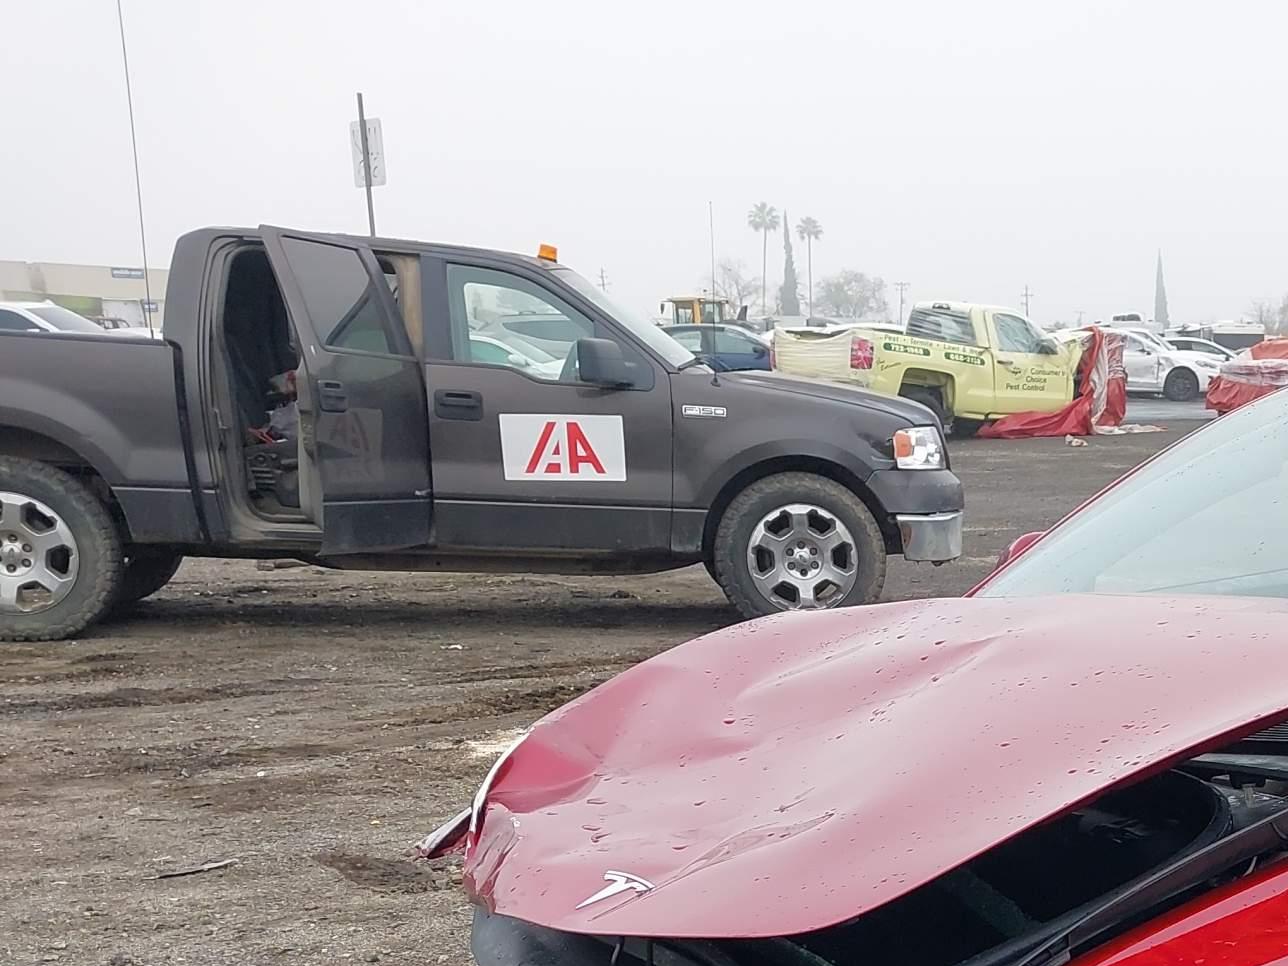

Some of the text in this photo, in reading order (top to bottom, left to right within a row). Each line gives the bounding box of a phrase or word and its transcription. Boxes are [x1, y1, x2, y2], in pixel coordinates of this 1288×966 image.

[1025, 375, 1047, 383] Choice
[1005, 382, 1045, 391] Pest Control
